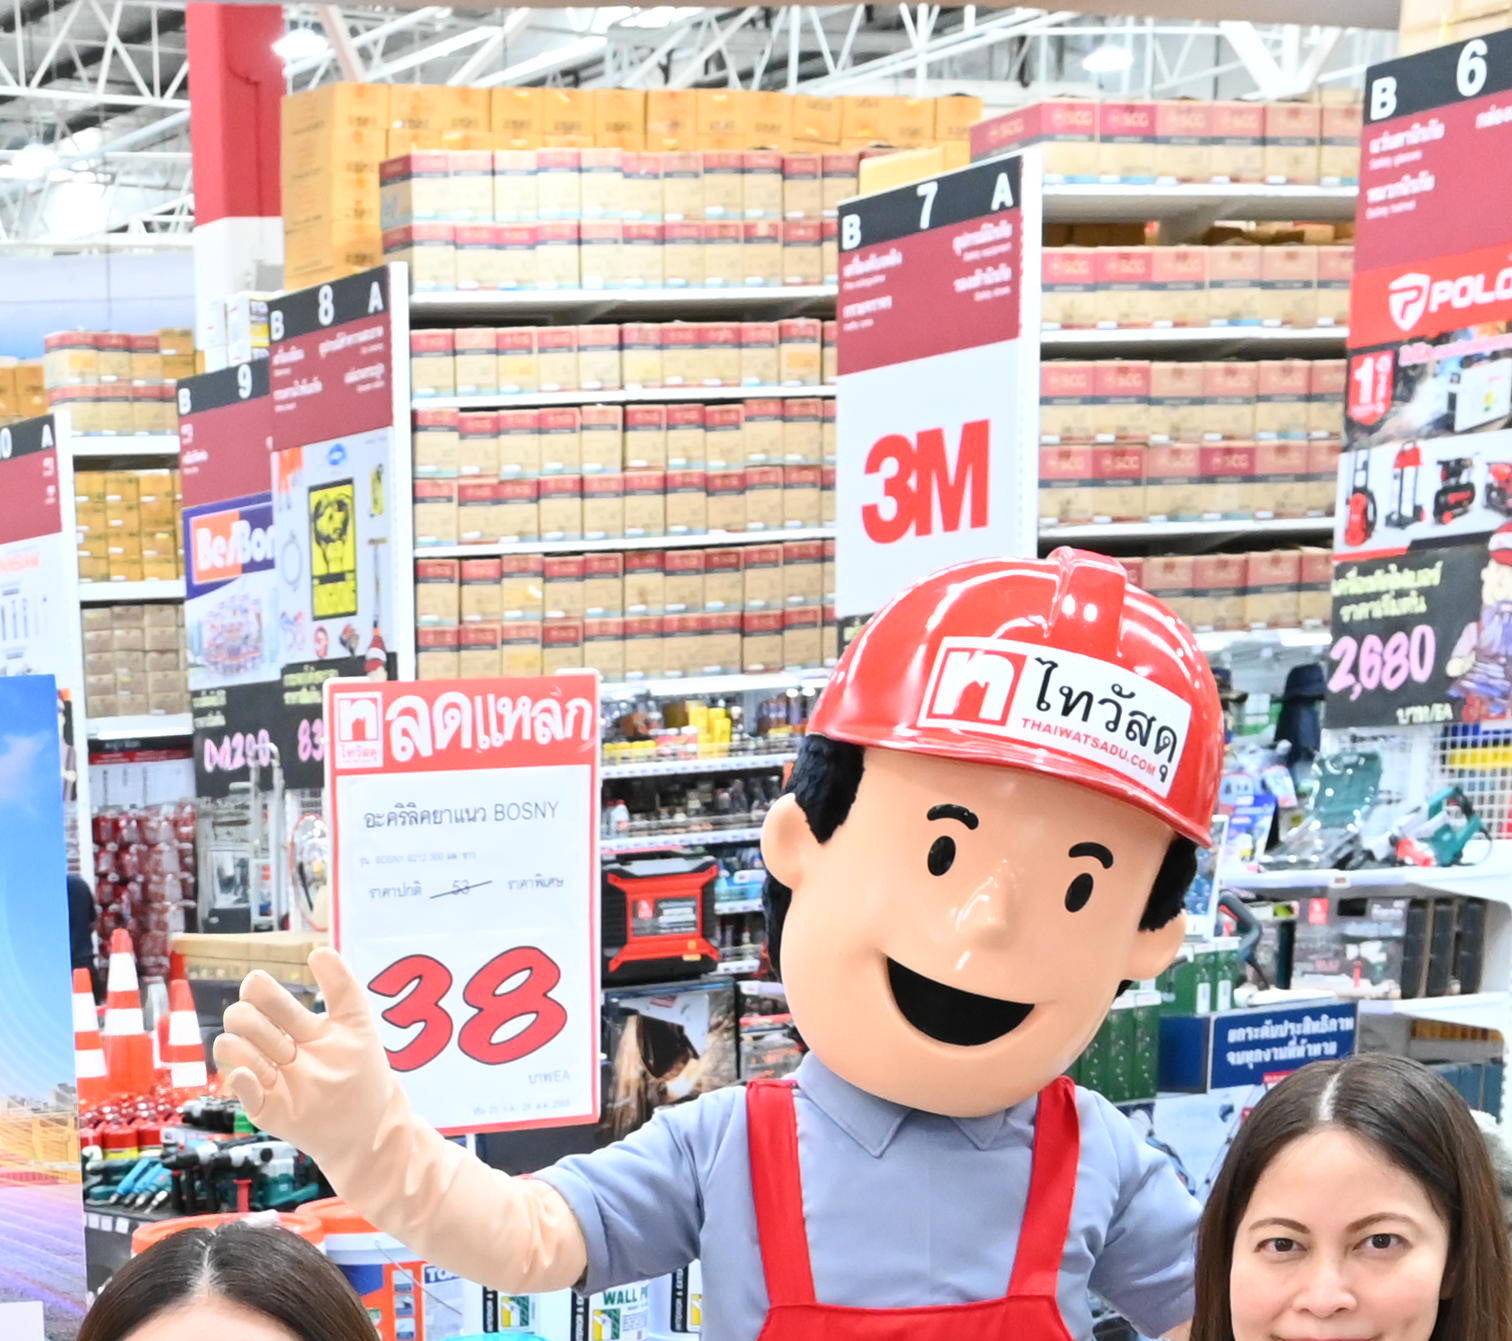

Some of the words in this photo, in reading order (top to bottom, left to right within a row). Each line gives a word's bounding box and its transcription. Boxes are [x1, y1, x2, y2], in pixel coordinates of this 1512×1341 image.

[1371, 76, 1397, 121] B
[1456, 40, 1488, 97] 6
[916, 182, 939, 231] 7
[990, 172, 1014, 211] A
[317, 284, 334, 326] 8
[236, 366, 253, 399] 9
[859, 419, 990, 546] 3M
[1327, 624, 1437, 702] 2,680
[1020, 716, 1157, 778] THAIWATSADU.COM
[1032, 654, 1178, 782] ไทวัสดุ
[494, 801, 559, 822] BOSNY
[368, 945, 569, 1073] 38
[602, 1290, 638, 1307] WALL
